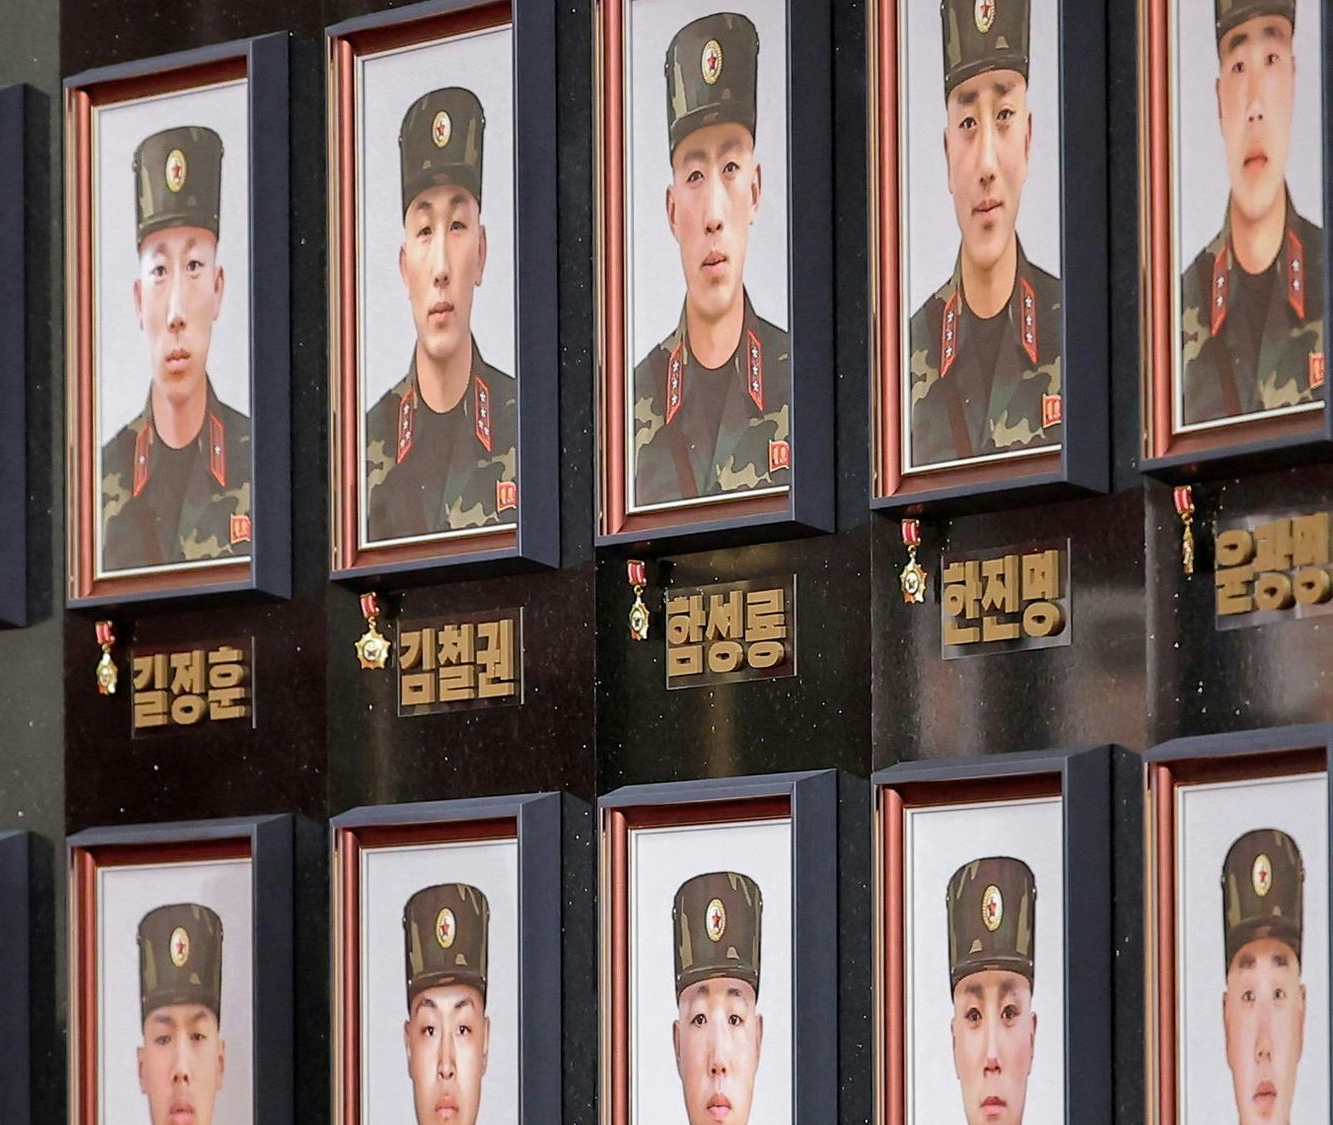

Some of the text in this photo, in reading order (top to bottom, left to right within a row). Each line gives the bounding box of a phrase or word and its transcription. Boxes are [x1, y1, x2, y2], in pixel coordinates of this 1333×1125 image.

[668, 588, 787, 677] 함성룡
[943, 549, 1063, 645] 한진명
[132, 646, 246, 728] 길정훈
[399, 619, 515, 706] 김철권
